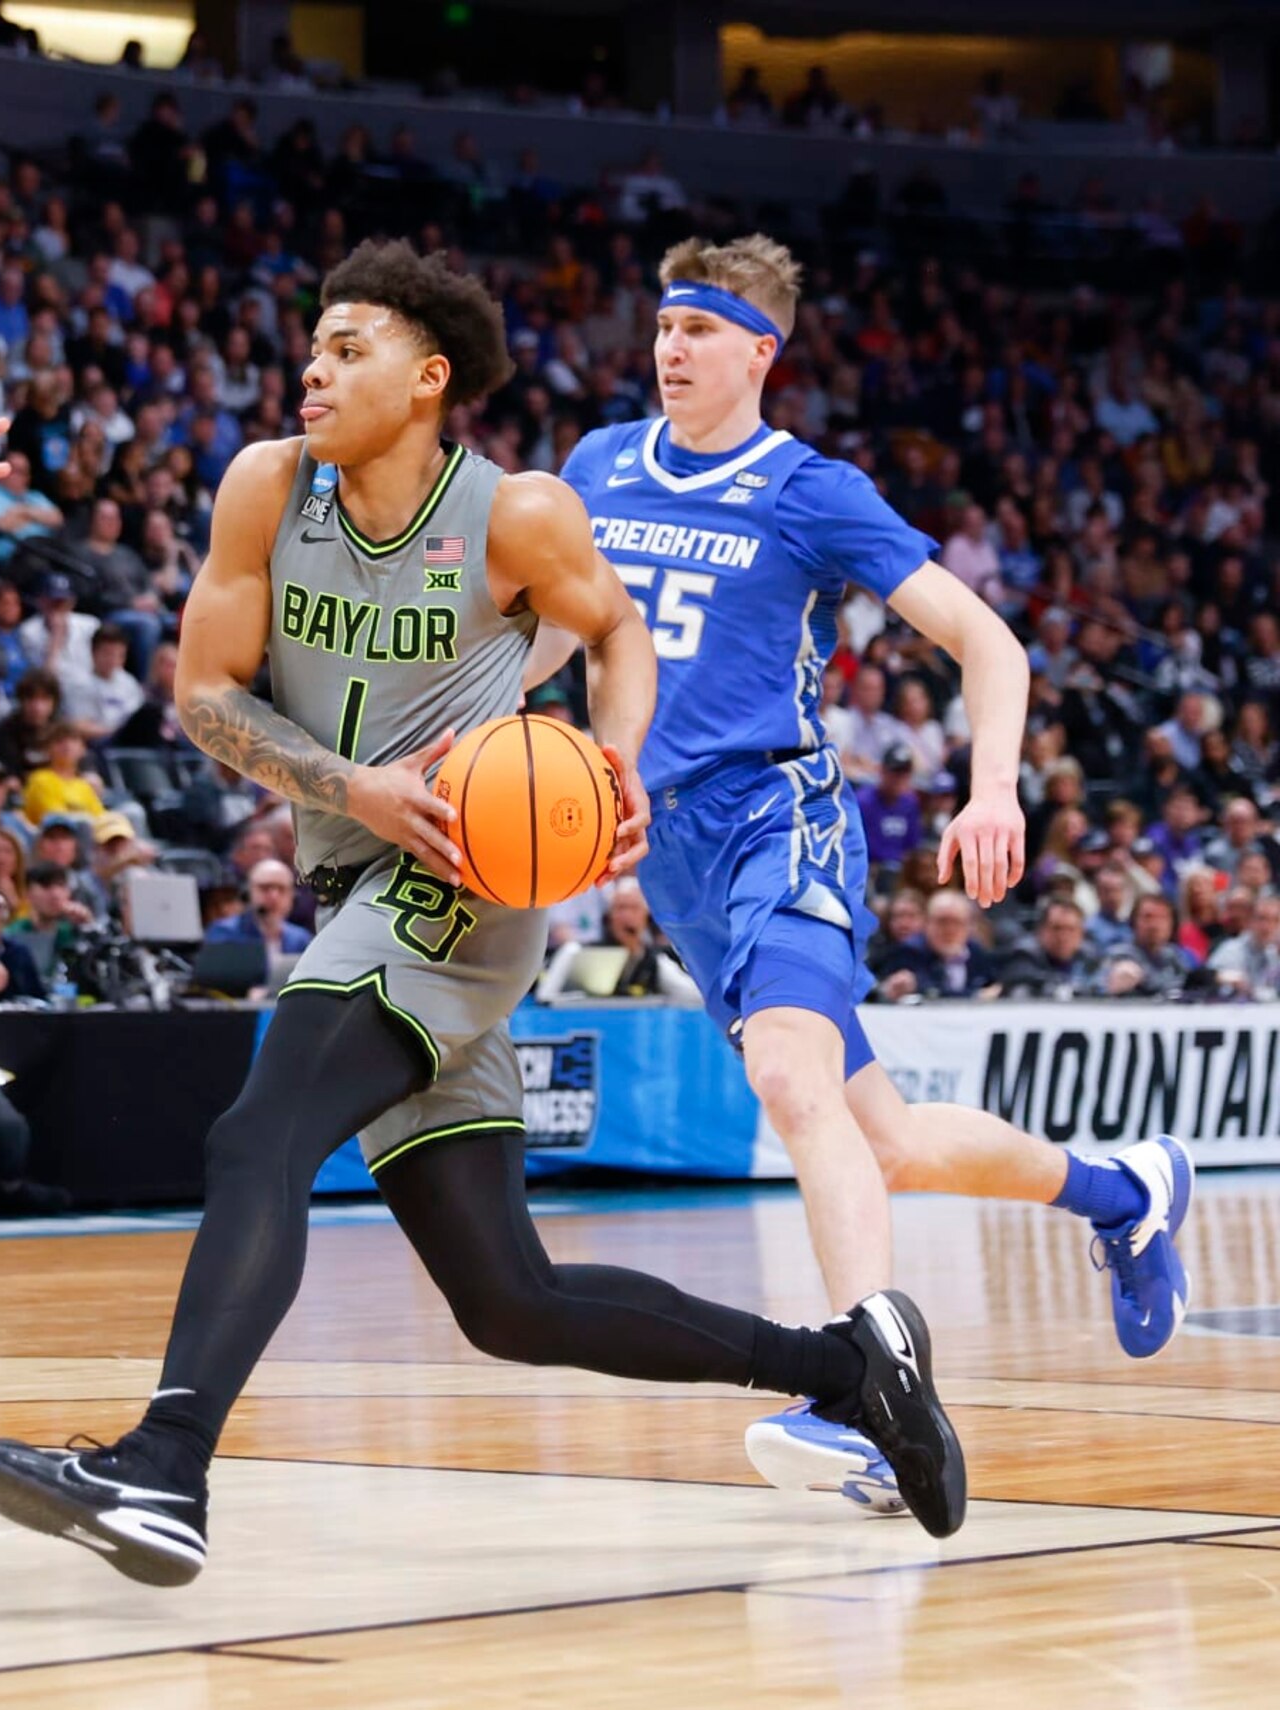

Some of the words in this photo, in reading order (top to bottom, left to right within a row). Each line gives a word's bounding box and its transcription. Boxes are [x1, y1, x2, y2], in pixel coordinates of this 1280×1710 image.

[304, 495, 331, 519] ONE
[590, 516, 761, 570] CREIGHTON
[427, 571, 459, 589] XII
[281, 581, 458, 663] BAYLOR
[337, 676, 369, 763] 1
[982, 1029, 1280, 1142] MOUNTAI
